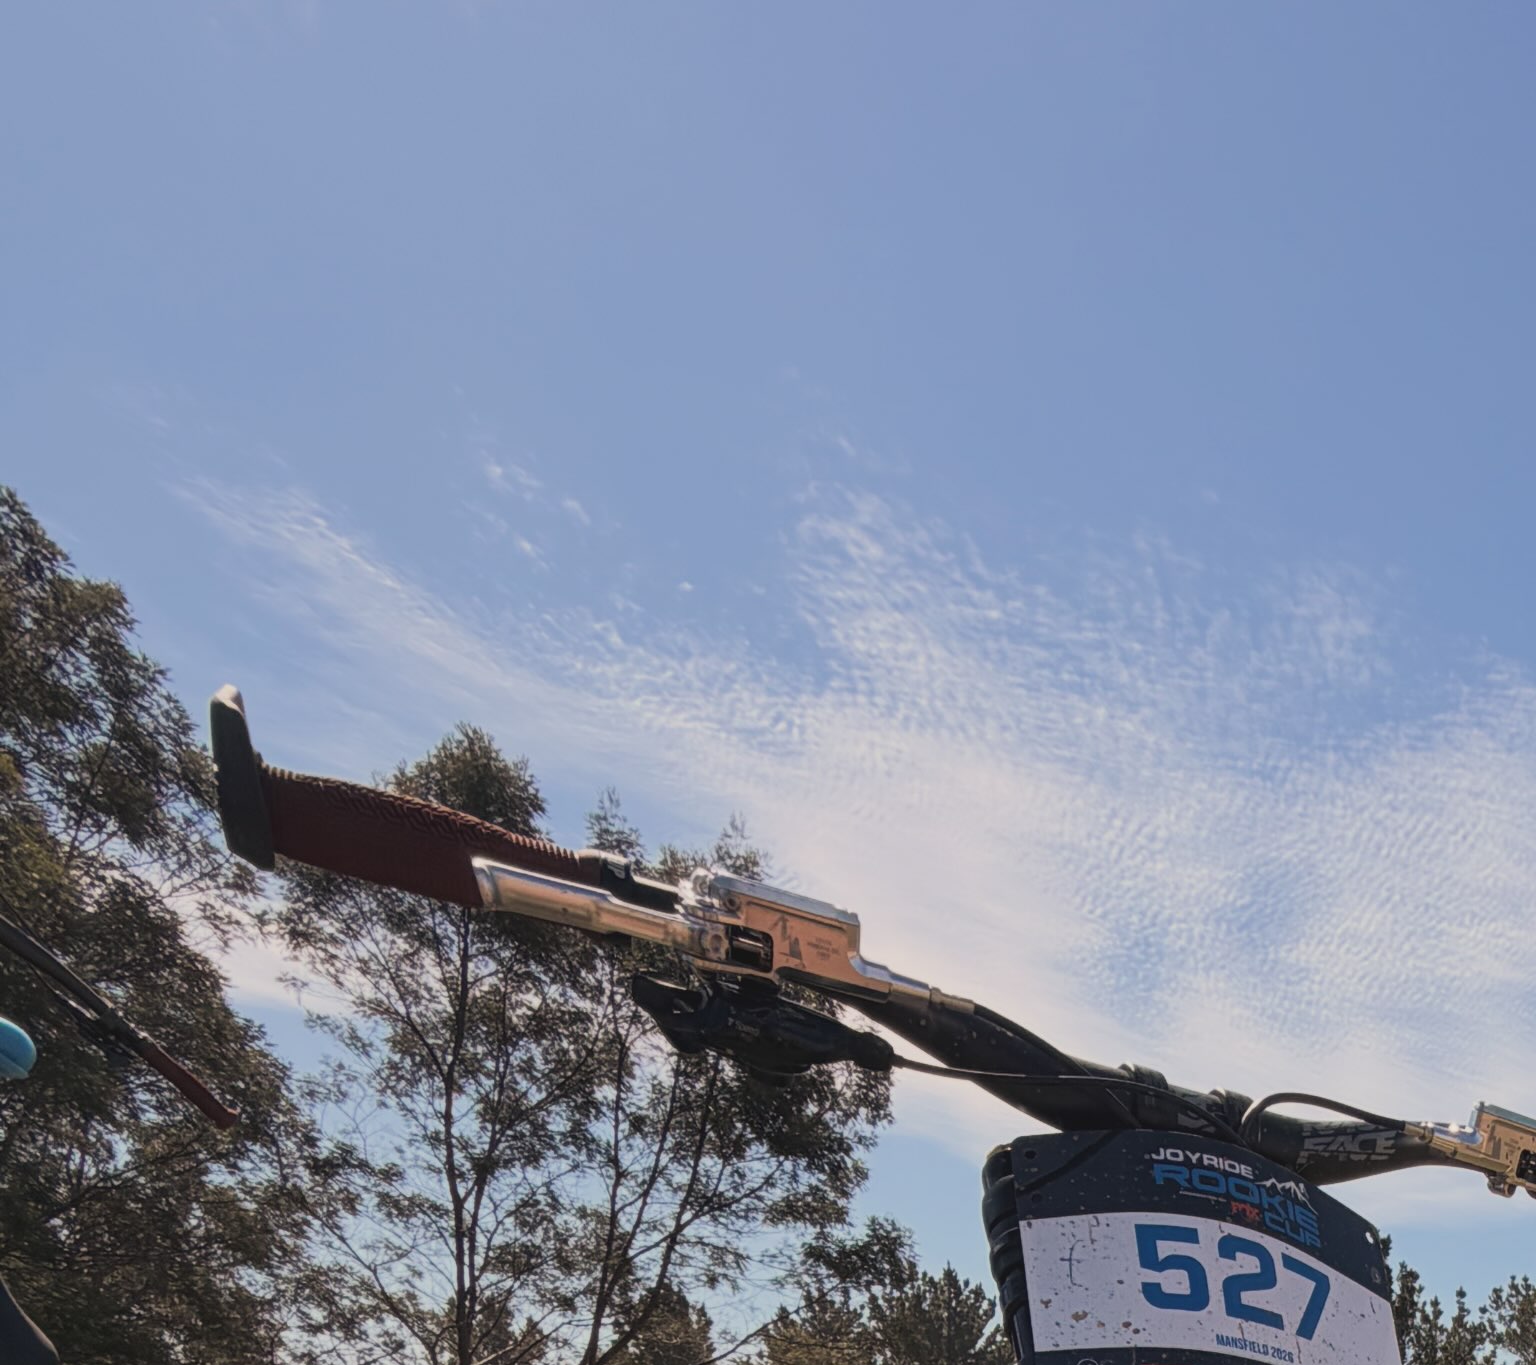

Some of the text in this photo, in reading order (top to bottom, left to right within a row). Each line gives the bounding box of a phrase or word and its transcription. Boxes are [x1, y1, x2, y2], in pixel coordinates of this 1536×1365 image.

[1151, 1147, 1254, 1179] JOYRIDE
[1153, 1164, 1319, 1237] ROOKIE
[1263, 1212, 1322, 1248] CUP
[1134, 1223, 1331, 1341] 527
[1215, 1333, 1294, 1363] MANSFIELD 2026
